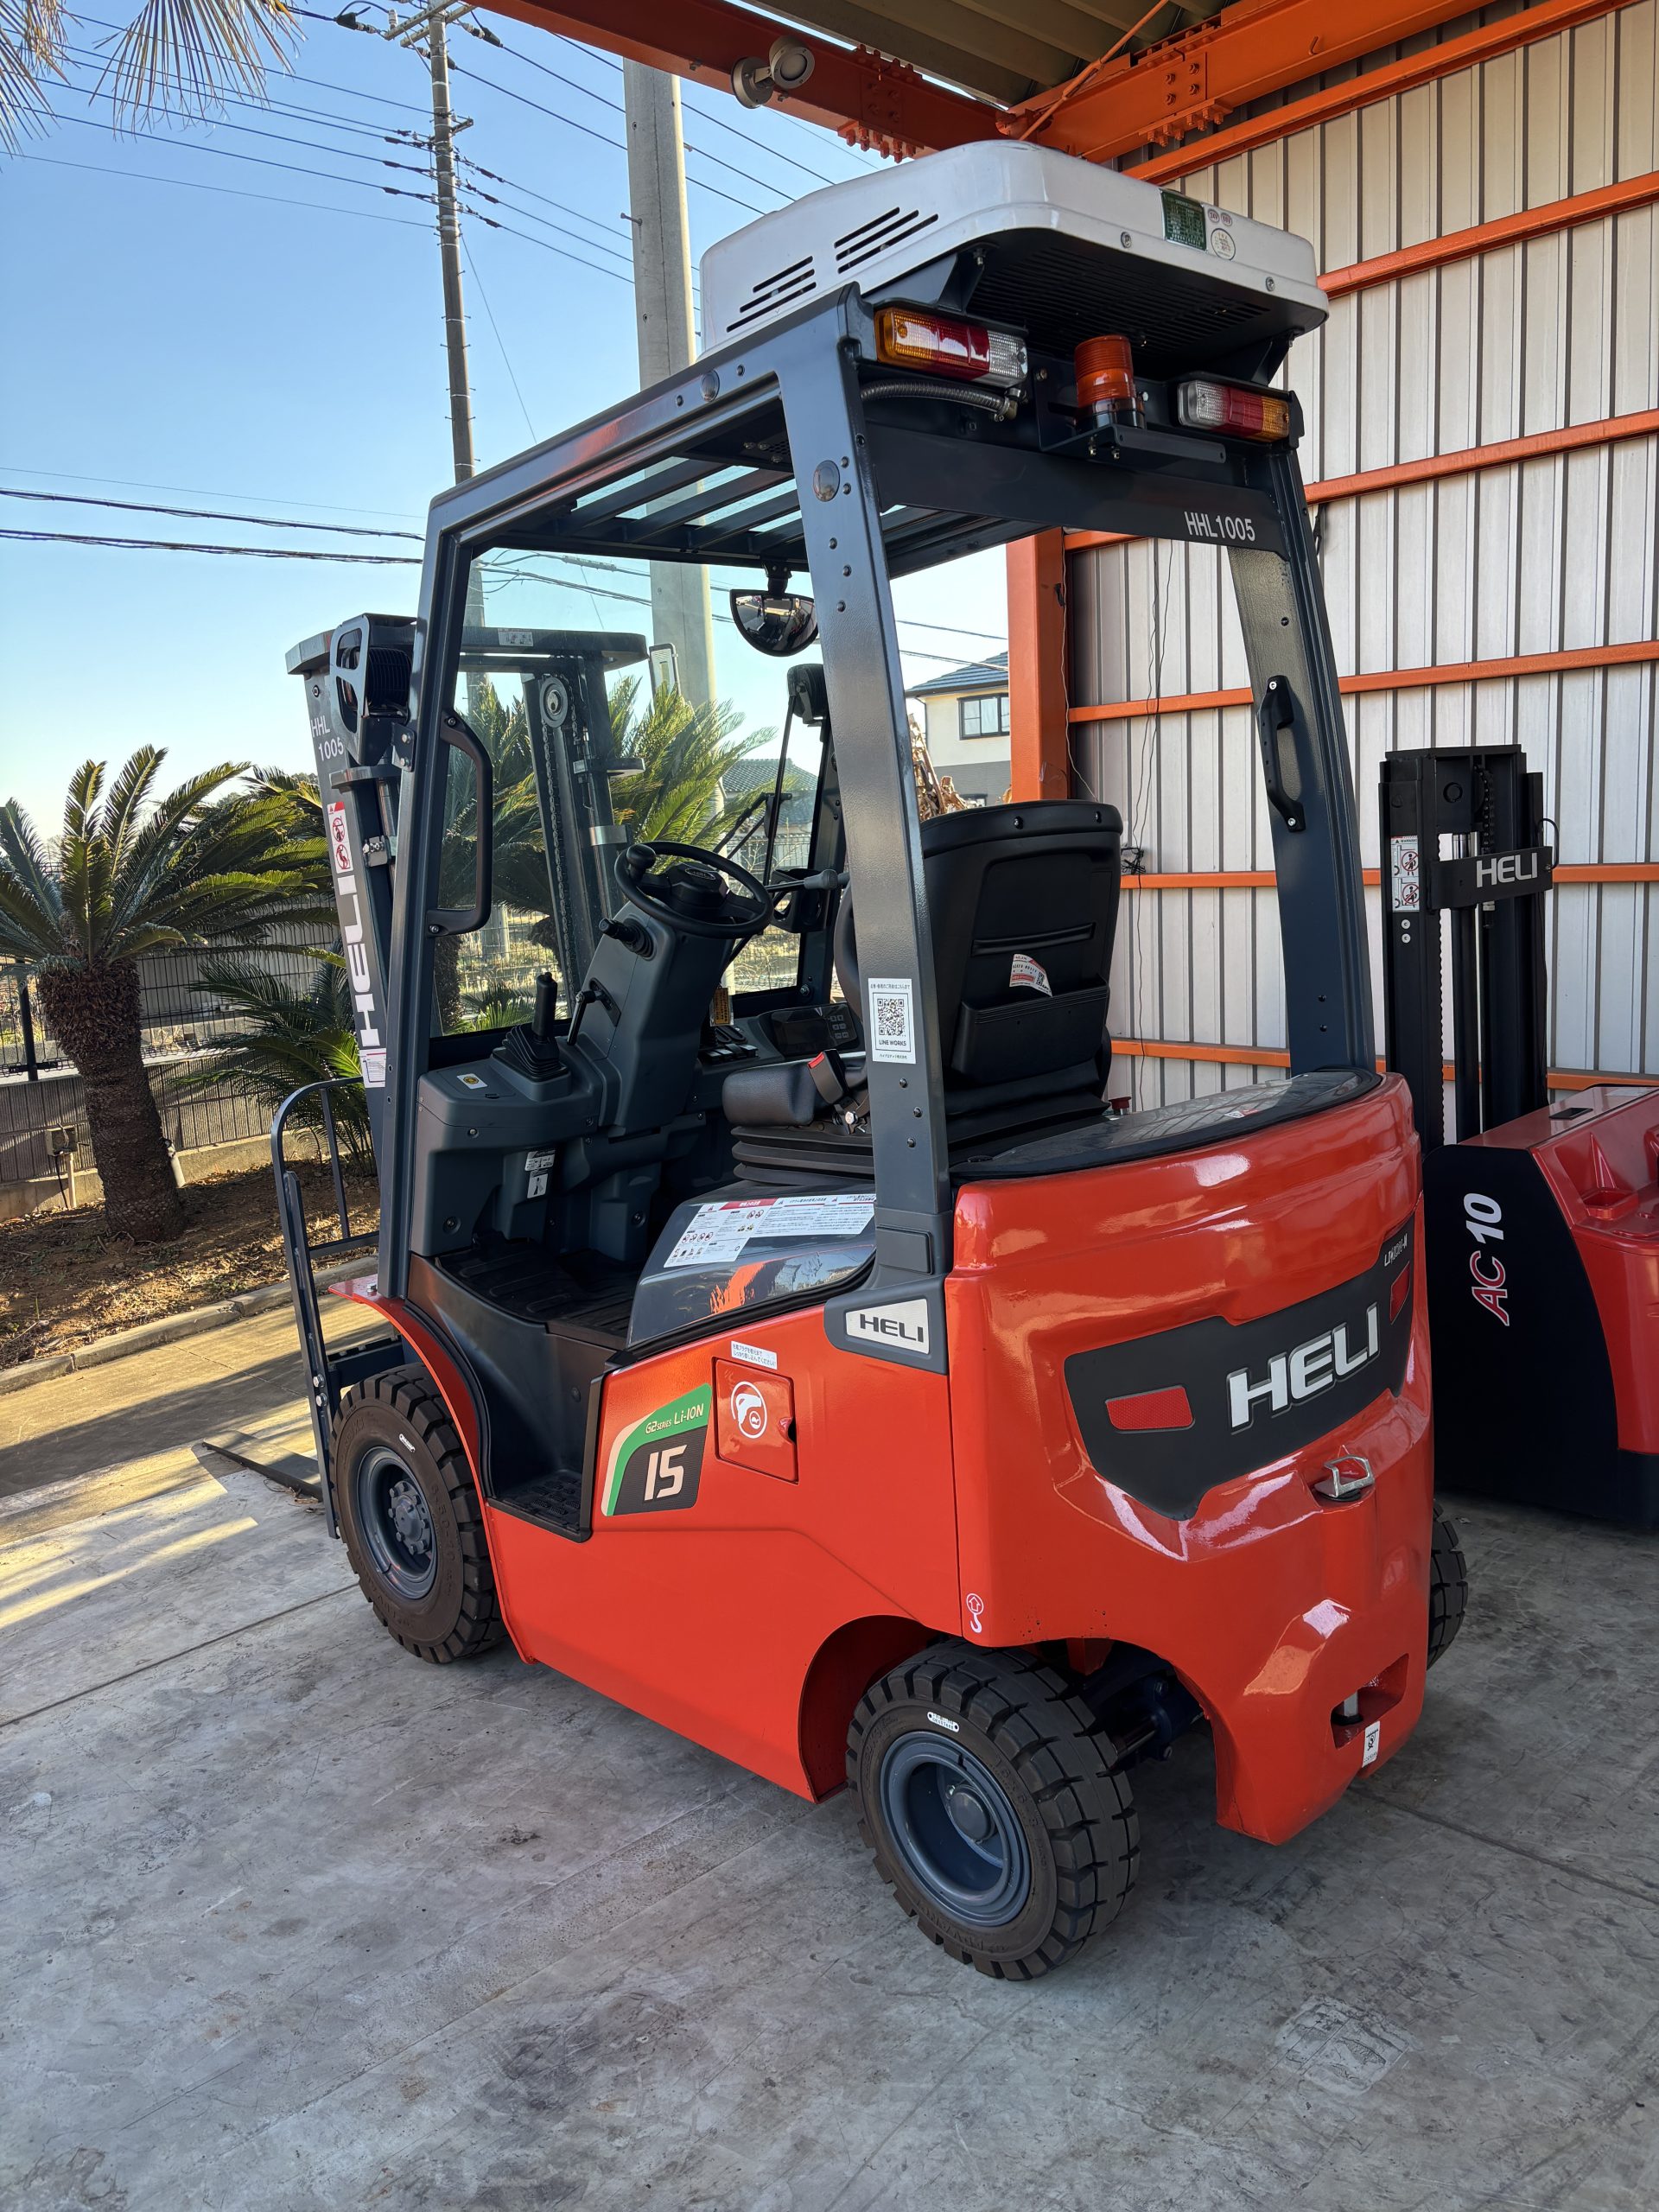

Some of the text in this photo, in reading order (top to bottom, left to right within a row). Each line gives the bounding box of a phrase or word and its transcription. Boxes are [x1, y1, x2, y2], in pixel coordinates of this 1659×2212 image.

[1184, 512, 1255, 542] HHL1005
[311, 715, 331, 738] HHL
[318, 736, 344, 761] 1005
[1476, 852, 1538, 888] HELI
[338, 875, 380, 1046] HELI
[1463, 1192, 1510, 1326] AC 10
[860, 1313, 924, 1343] HELI
[1228, 1305, 1379, 1429] HELI
[674, 1402, 704, 1425] Li-ION
